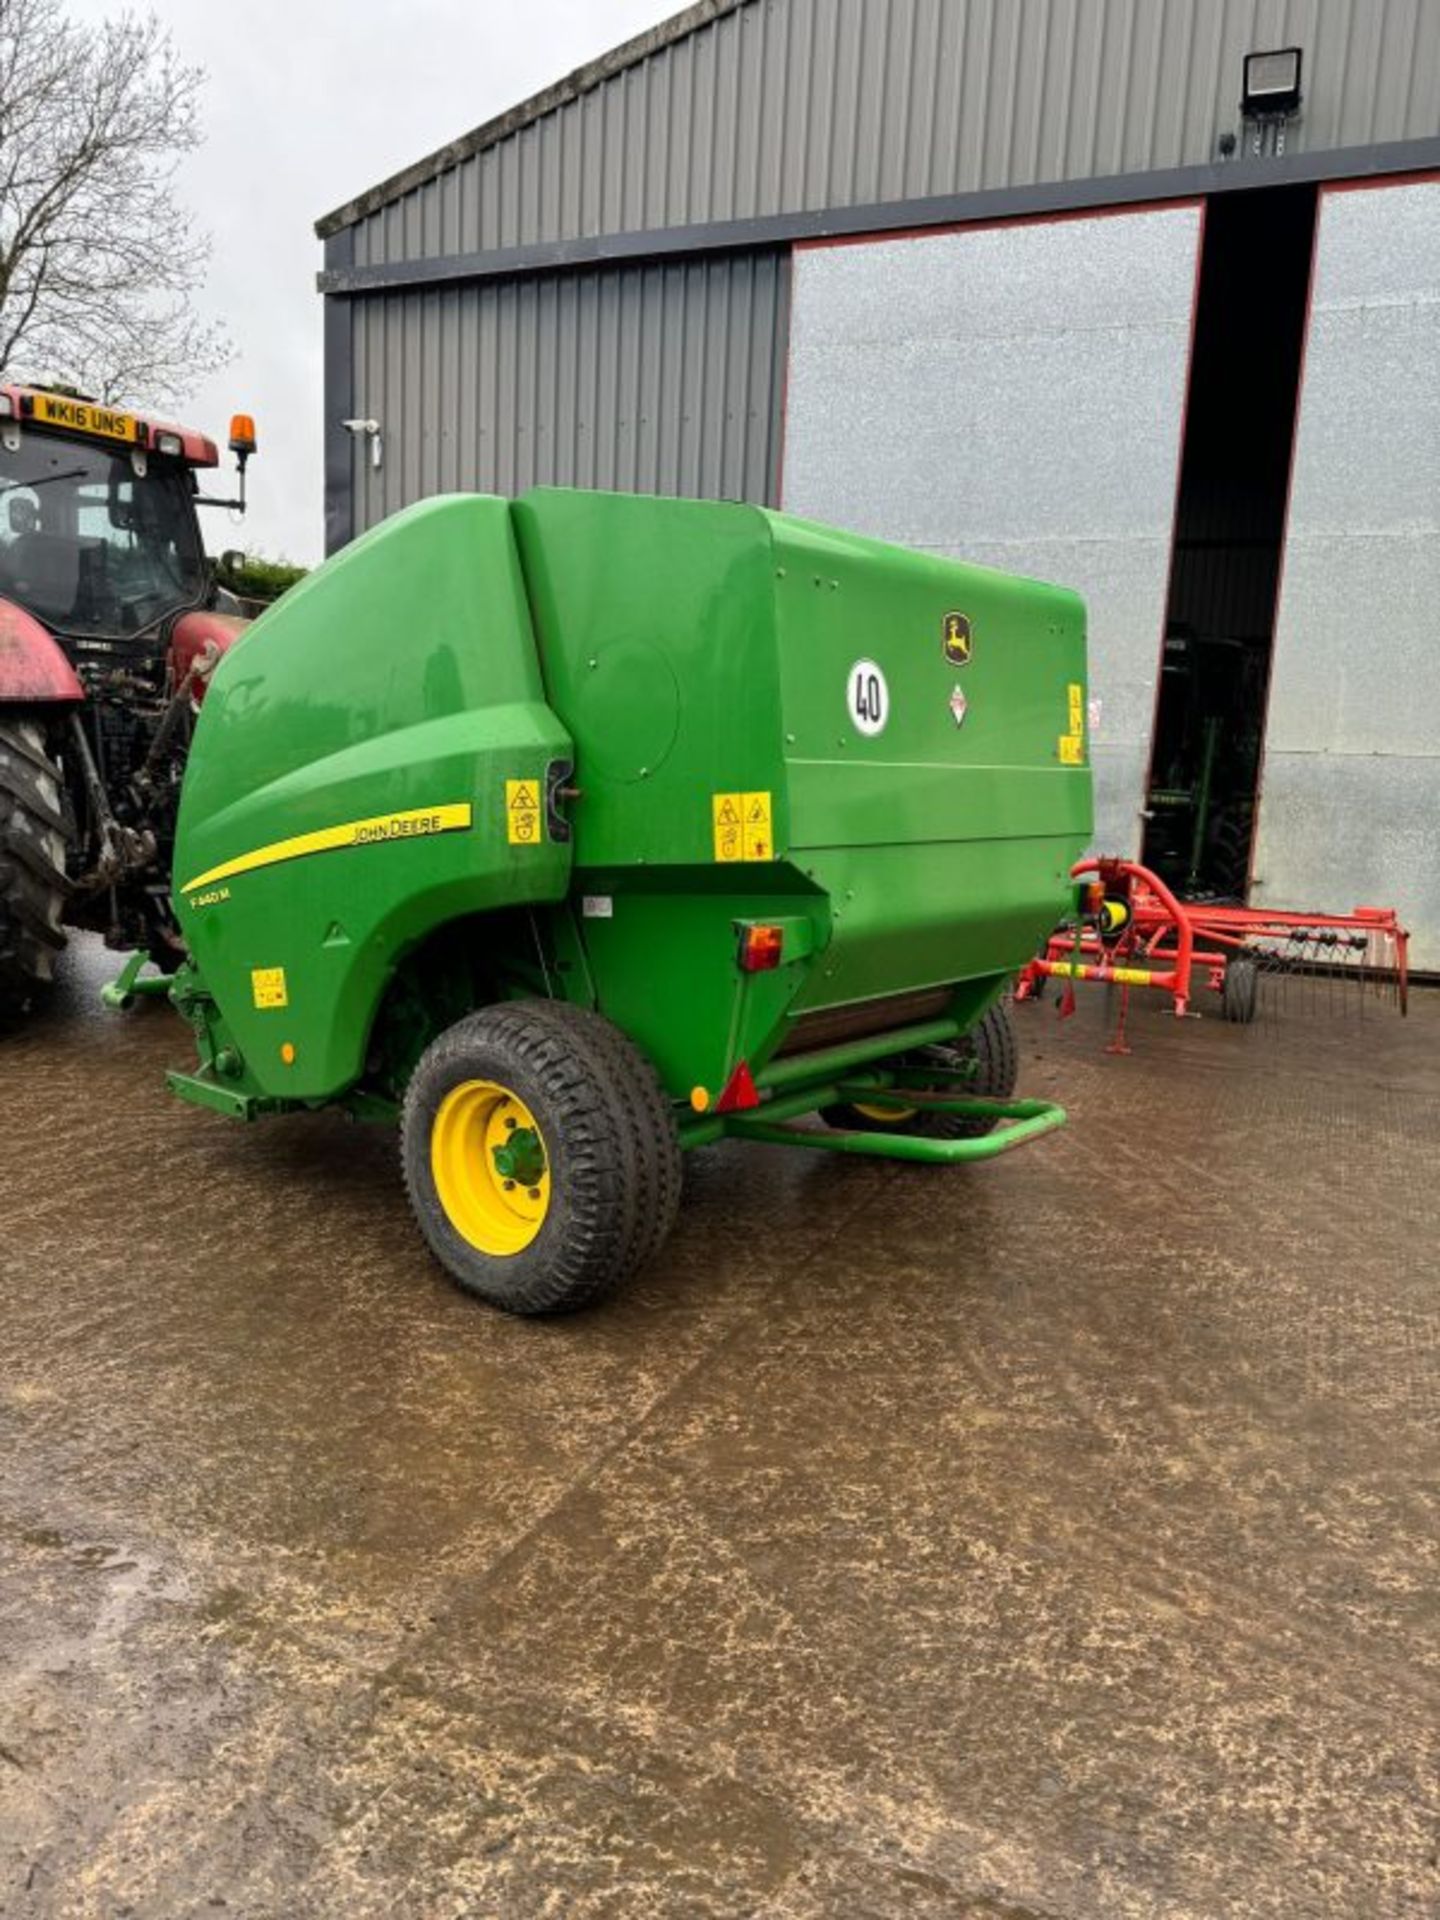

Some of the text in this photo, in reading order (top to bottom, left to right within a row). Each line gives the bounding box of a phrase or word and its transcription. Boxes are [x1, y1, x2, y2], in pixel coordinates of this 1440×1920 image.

[45, 398, 126, 435] WK16 UNS
[856, 673, 882, 722] 40
[352, 815, 441, 845] JOHN DEERE
